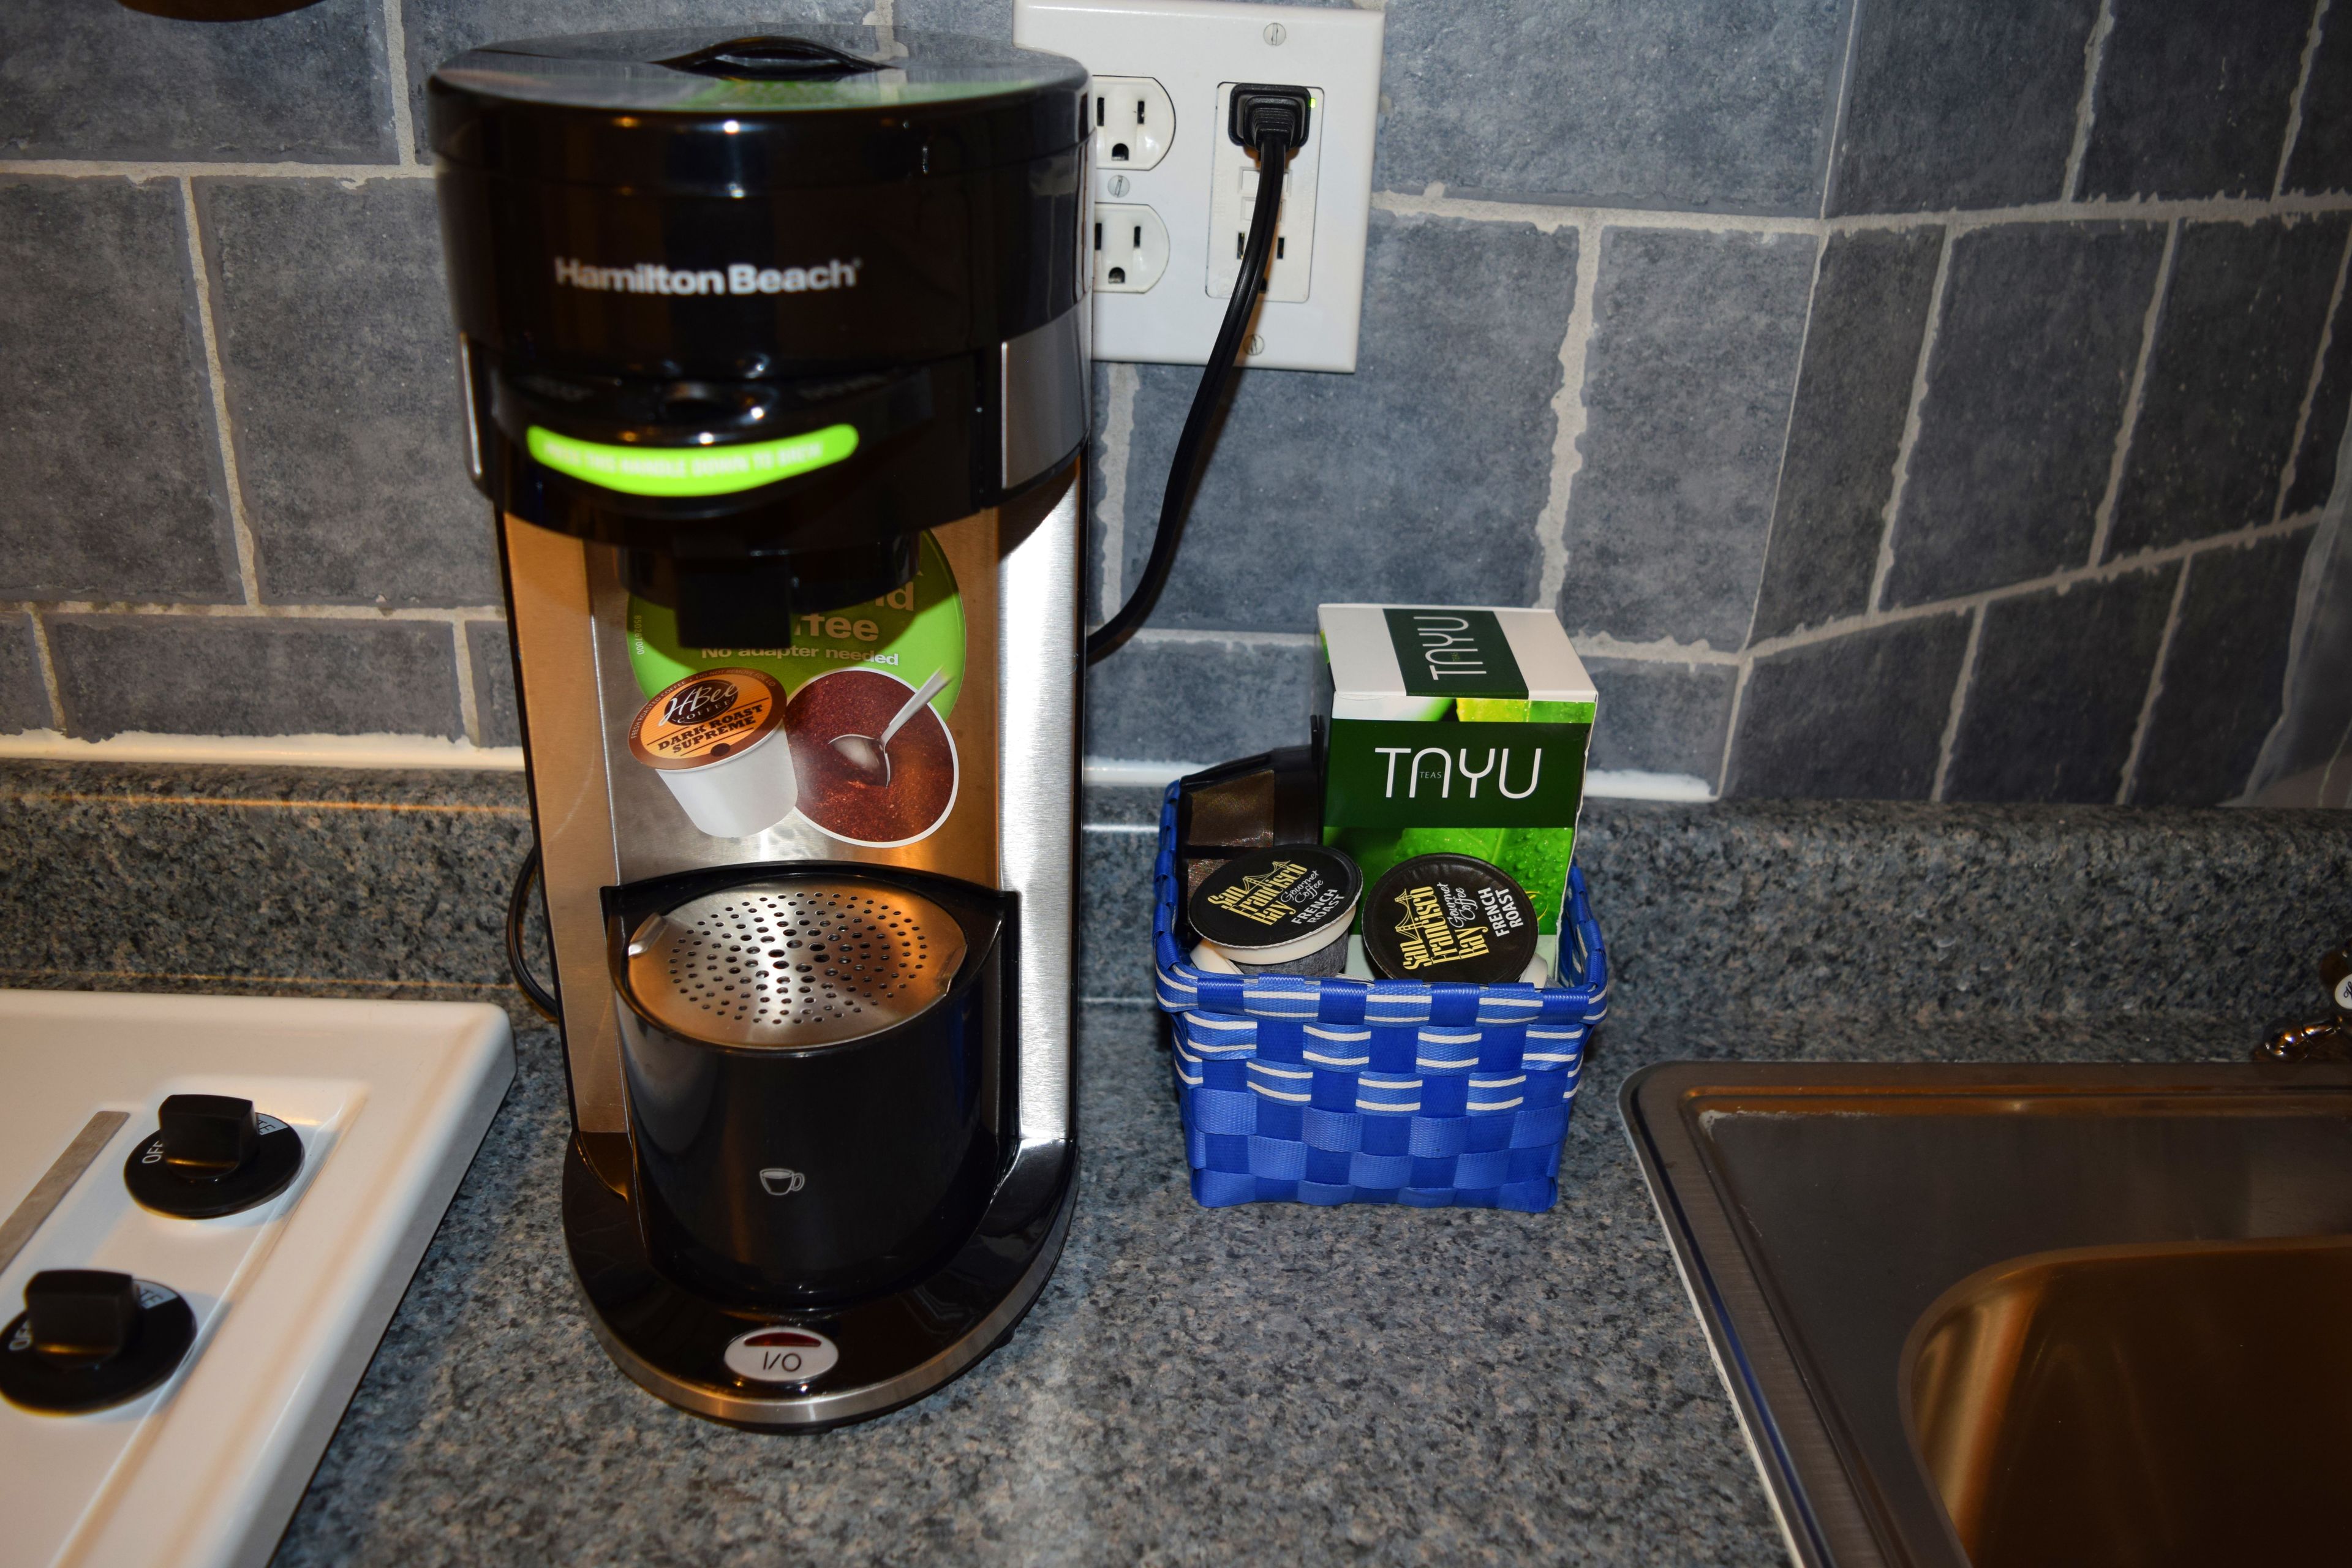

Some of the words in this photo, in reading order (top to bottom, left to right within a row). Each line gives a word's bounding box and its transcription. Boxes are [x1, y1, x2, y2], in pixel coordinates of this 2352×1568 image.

[554, 256, 726, 296] Hamilton
[702, 648, 732, 659] No
[738, 645, 820, 660] adapter
[826, 648, 899, 666] needed
[1412, 616, 1487, 680] TAYU
[638, 697, 662, 721] ROASTED
[677, 699, 731, 724] COFFEE
[657, 725, 707, 750] DARK
[710, 704, 764, 728] ROAST
[672, 715, 757, 753] SUPREME
[1374, 747, 1542, 799] TAYU
[1419, 771, 1442, 779] TEAS
[1207, 886, 1250, 910] San
[1227, 863, 1308, 918] Francisco
[1280, 870, 1320, 903] Gourmet
[1294, 879, 1324, 903] Coffee
[1250, 900, 1297, 926] Bay
[1291, 889, 1338, 924] FRENCH
[1306, 894, 1345, 923] ROAST
[1437, 882, 1464, 928] Gourmet
[1452, 887, 1478, 921] Coffee
[1477, 887, 1510, 937] FRENCH
[1495, 888, 1524, 929] ROAST
[1410, 886, 1461, 965] Francisco
[1400, 939, 1433, 970] San
[1454, 926, 1490, 960] Bay
[763, 1351, 802, 1373] I/O
